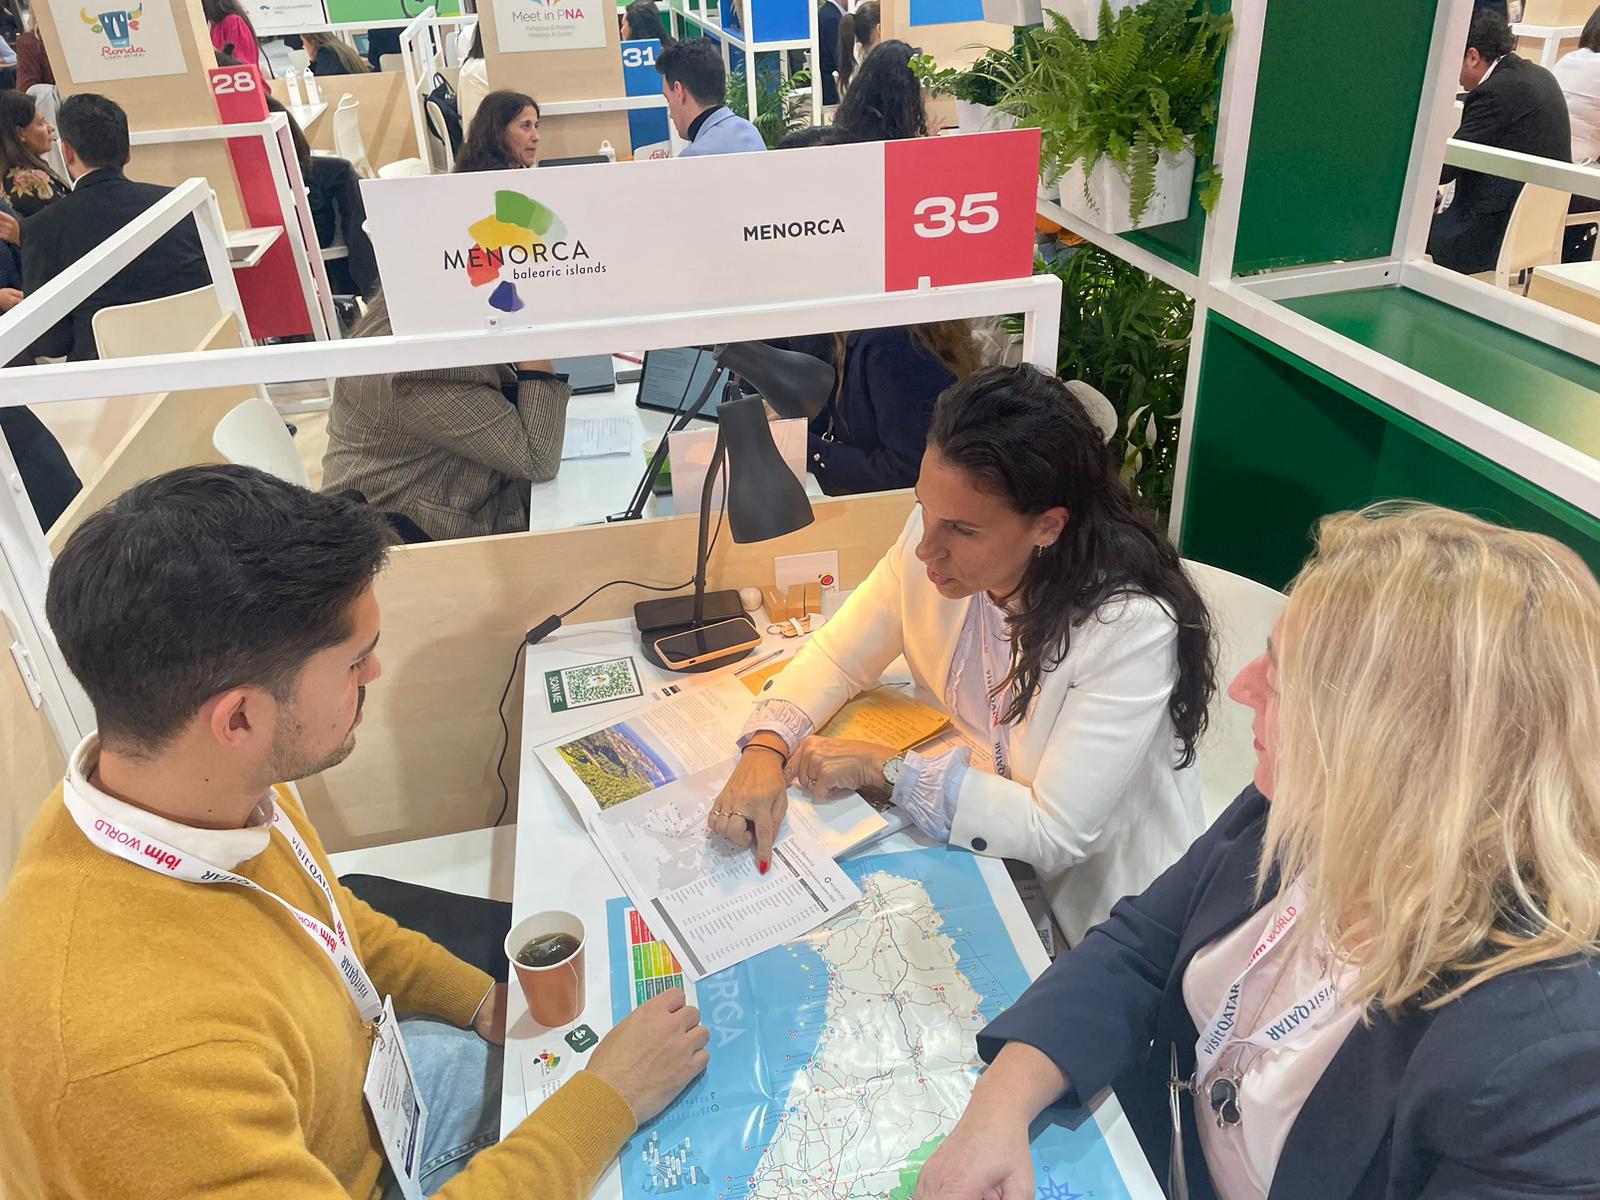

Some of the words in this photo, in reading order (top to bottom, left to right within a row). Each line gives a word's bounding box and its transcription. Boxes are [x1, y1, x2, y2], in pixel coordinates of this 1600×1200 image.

[512, 10, 541, 23] Meet
[544, 11, 555, 21] in
[557, 8, 584, 20] PNA
[101, 44, 146, 57] Ronda
[622, 46, 656, 68] 31
[212, 71, 256, 95] 28
[913, 191, 999, 238] 35
[743, 218, 846, 242] MENORCA
[443, 240, 590, 270] MENORCA
[513, 265, 562, 280] balearic
[566, 261, 608, 276] islands
[549, 676, 560, 692] SCAN
[94, 819, 141, 851] WORLD
[1266, 906, 1297, 942] WORLD
[341, 954, 370, 1000] visitQATAR
[1203, 983, 1240, 1056] visitQATAR
[1265, 983, 1336, 1042] visitQATAR
